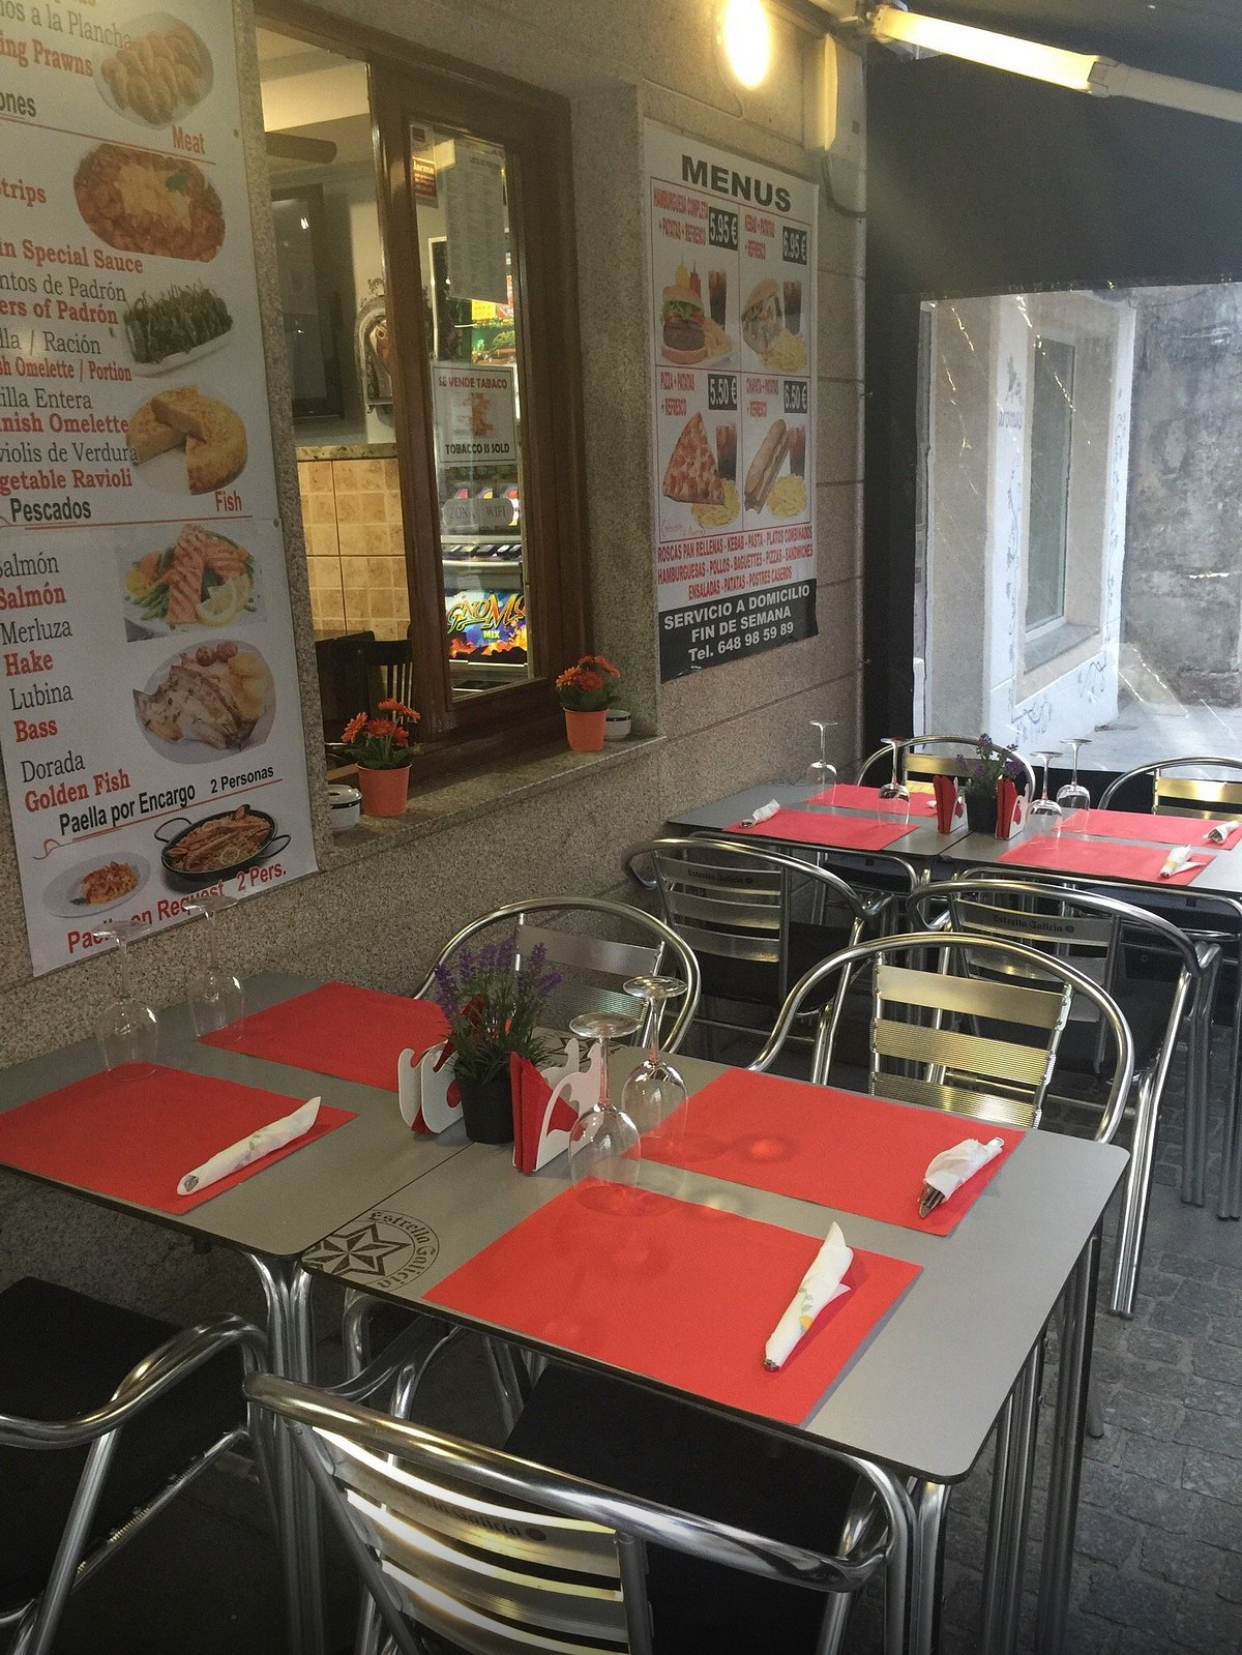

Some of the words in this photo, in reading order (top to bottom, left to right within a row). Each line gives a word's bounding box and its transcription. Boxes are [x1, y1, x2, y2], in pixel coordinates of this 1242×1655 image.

[31, 8, 42, 26] a
[46, 4, 63, 32] la
[68, 11, 131, 49] Plancha
[32, 39, 94, 77] Prawns
[172, 125, 206, 154] Meat
[0, 177, 47, 208] trips
[682, 154, 792, 212] MENUS
[709, 212, 729, 242] 5.95
[22, 238, 89, 267] Special
[93, 249, 144, 274] Sauce
[783, 230, 799, 259] 6.95
[43, 274, 63, 296] de
[68, 276, 127, 302] Padrón
[33, 298, 52, 319] of
[57, 300, 119, 324] Padrón
[43, 330, 102, 355] Ración
[16, 356, 75, 379] Omelette
[88, 361, 133, 382] Portion
[448, 376, 475, 388] VENDE
[477, 378, 507, 389] TABACO
[0, 387, 30, 408] illa
[34, 387, 93, 409] Entera
[709, 378, 730, 405] 5.50
[0, 412, 44, 433] nish
[50, 413, 130, 434] Omelette
[47, 443, 68, 463] de
[72, 442, 139, 463] Verdura
[445, 443, 482, 455] TOBACCO
[491, 443, 510, 454] SOLD
[71, 468, 133, 488] Ravioli
[9, 497, 91, 523] Pescados
[215, 490, 242, 512] Fish
[658, 544, 683, 563] ROSCAS
[0, 582, 67, 611] Salmón
[664, 602, 732, 630] SERVICIO
[736, 599, 745, 613] A
[749, 584, 810, 609] DOMICILIO
[1, 618, 73, 645] Merluza
[483, 630, 500, 639] MIX
[691, 624, 715, 642] FIN
[719, 619, 737, 636] DE
[740, 606, 792, 630] SEMANA
[688, 645, 714, 661] Tel.
[718, 635, 741, 654] 648
[744, 631, 760, 647] 98
[763, 625, 777, 641] 59
[780, 621, 794, 636] 89
[3, 650, 54, 677] Hake
[9, 683, 74, 711] Lubina
[14, 719, 58, 743] Bass
[20, 750, 85, 783] Dorada
[24, 781, 89, 813] Golden
[93, 768, 131, 797] Fish
[59, 806, 107, 836] Paella
[111, 800, 135, 828] por
[139, 783, 196, 814] Encargo
[210, 778, 218, 795] 2
[221, 764, 274, 791] Personas
[236, 873, 246, 892] 2
[249, 861, 287, 887] Pers.
[993, 915, 1027, 927] Estrella
[1029, 920, 1063, 933] Galicia
[367, 1211, 431, 1244] Estrella
[377, 1245, 437, 1289] Galicia
